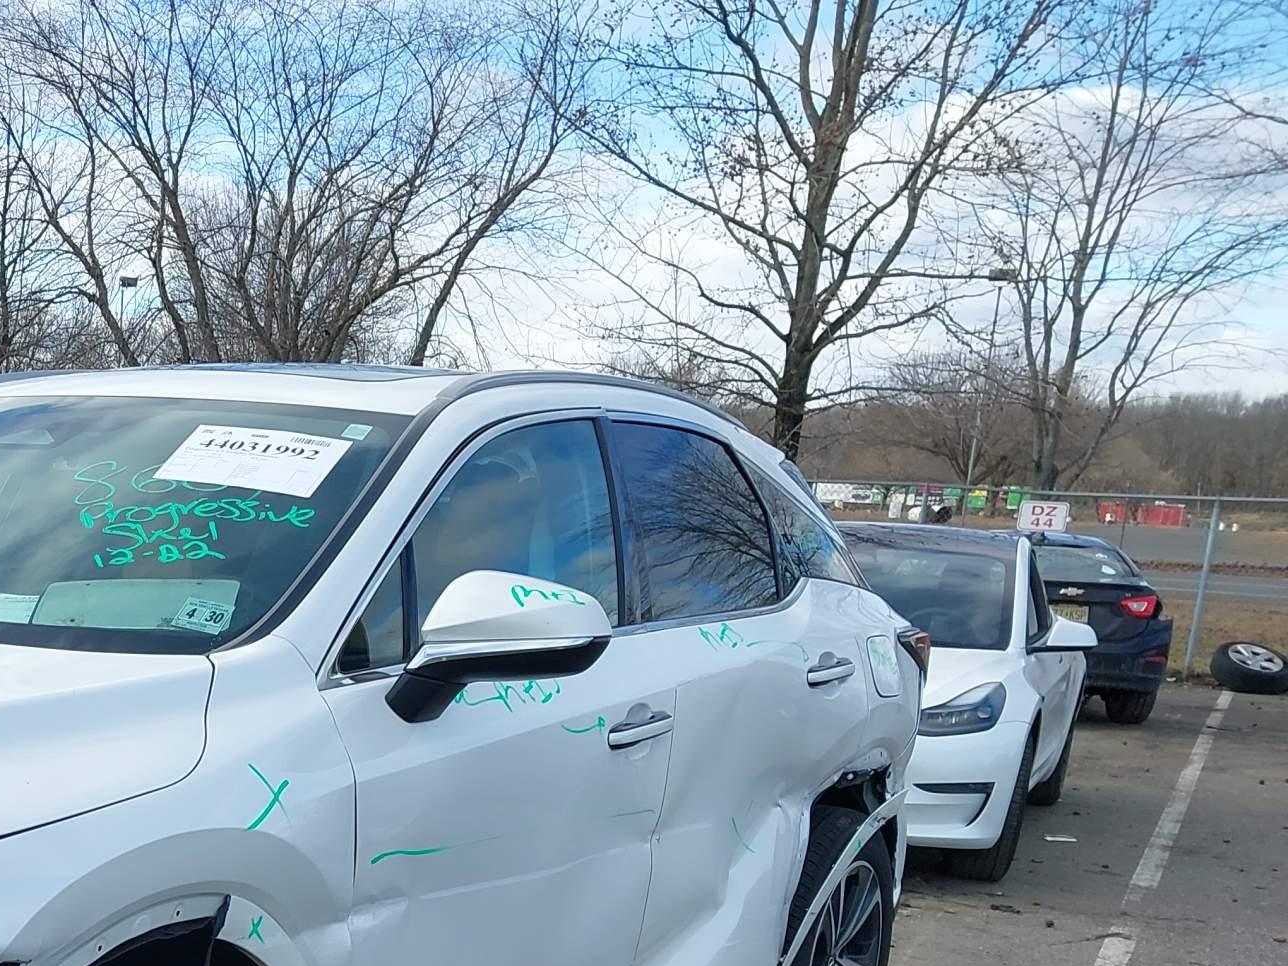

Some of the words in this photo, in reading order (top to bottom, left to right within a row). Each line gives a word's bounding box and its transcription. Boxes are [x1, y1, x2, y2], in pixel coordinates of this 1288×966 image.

[199, 438, 320, 461] 44031992
[1032, 505, 1058, 517] DZ
[1030, 518, 1054, 528] 44
[185, 607, 198, 619] 4
[204, 610, 225, 624] 30
